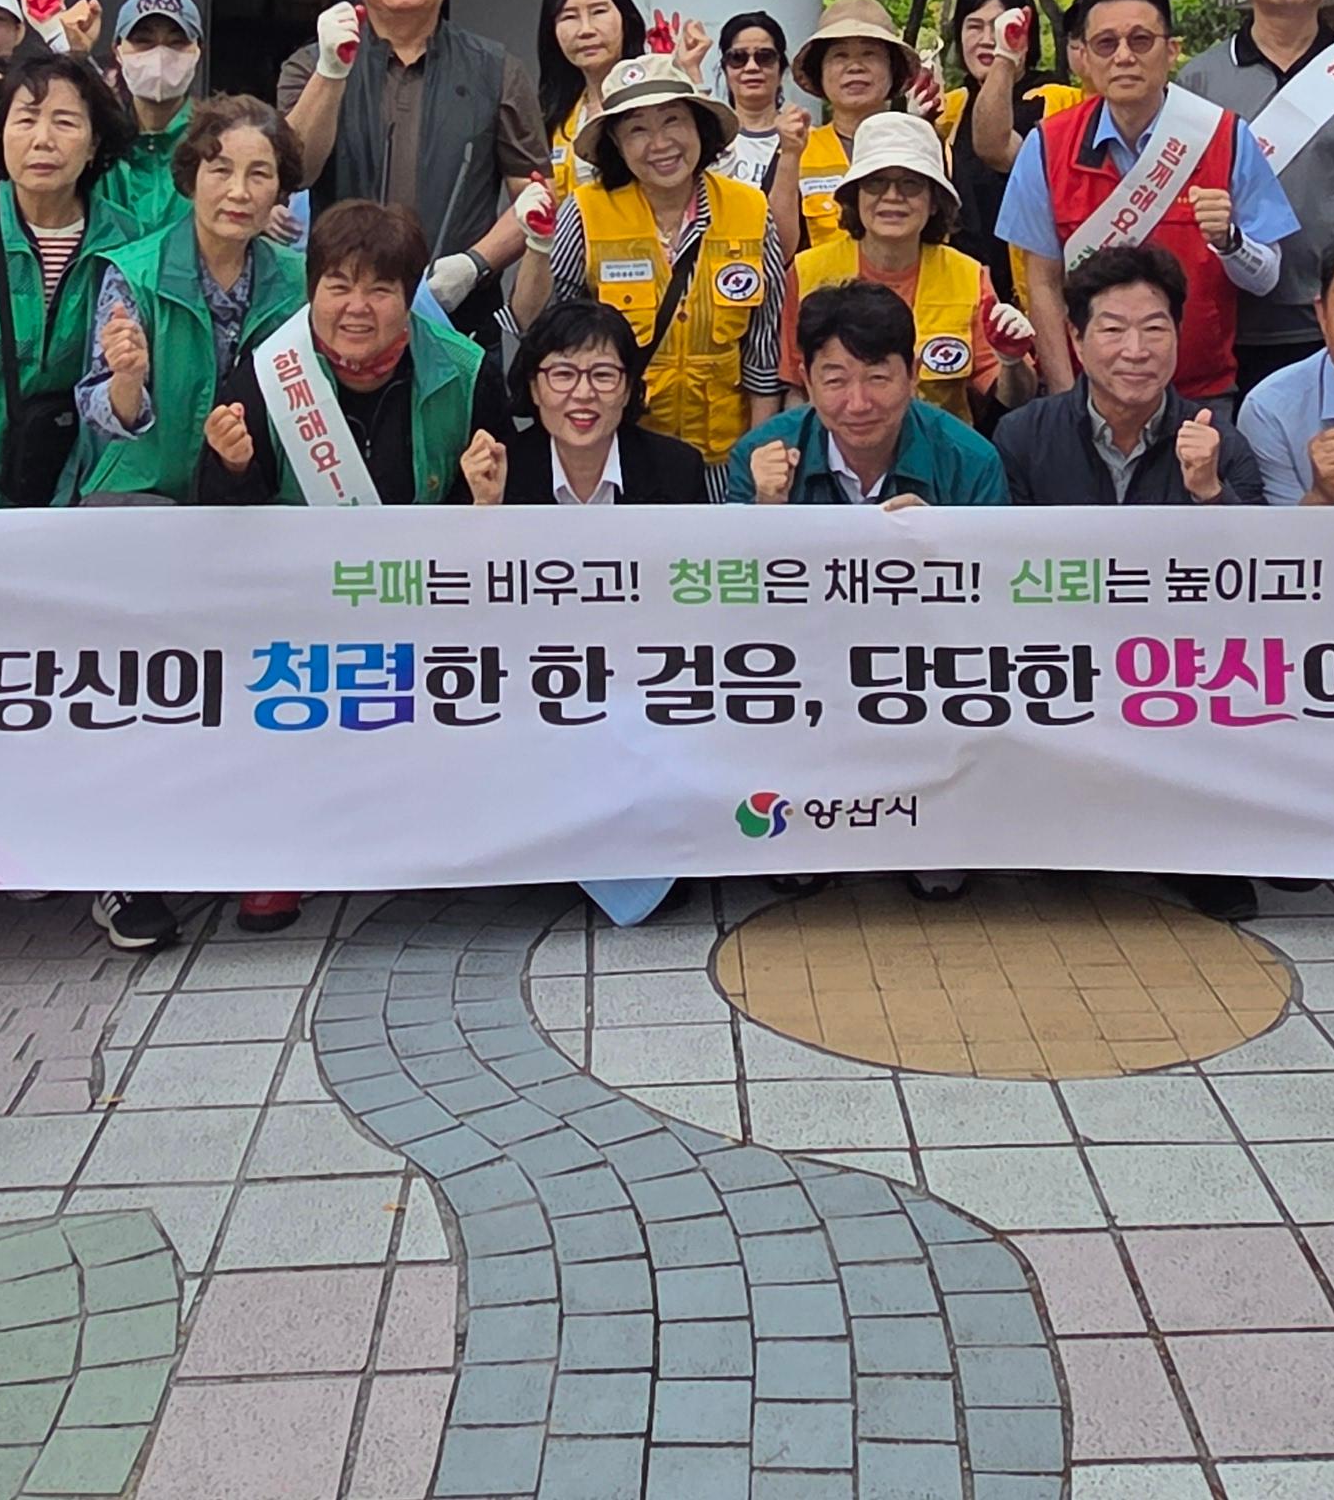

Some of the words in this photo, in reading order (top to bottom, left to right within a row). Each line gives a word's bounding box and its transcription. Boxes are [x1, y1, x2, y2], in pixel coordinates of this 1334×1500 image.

[1100, 136, 1188, 250] 함께해요!
[272, 348, 342, 499] 함께해요!
[334, 561, 471, 607] 부패는
[489, 561, 640, 606] 비우고!
[671, 560, 810, 604] 청렴은
[826, 559, 981, 606] 채우고!
[1012, 559, 1151, 604] 신뢰는
[1167, 559, 1323, 603] 높이고!
[248, 643, 509, 732] 청렴한
[531, 647, 615, 726] 한
[638, 644, 823, 728] 걸음,
[851, 646, 1101, 728] 당당한
[804, 796, 917, 830] 양산시
